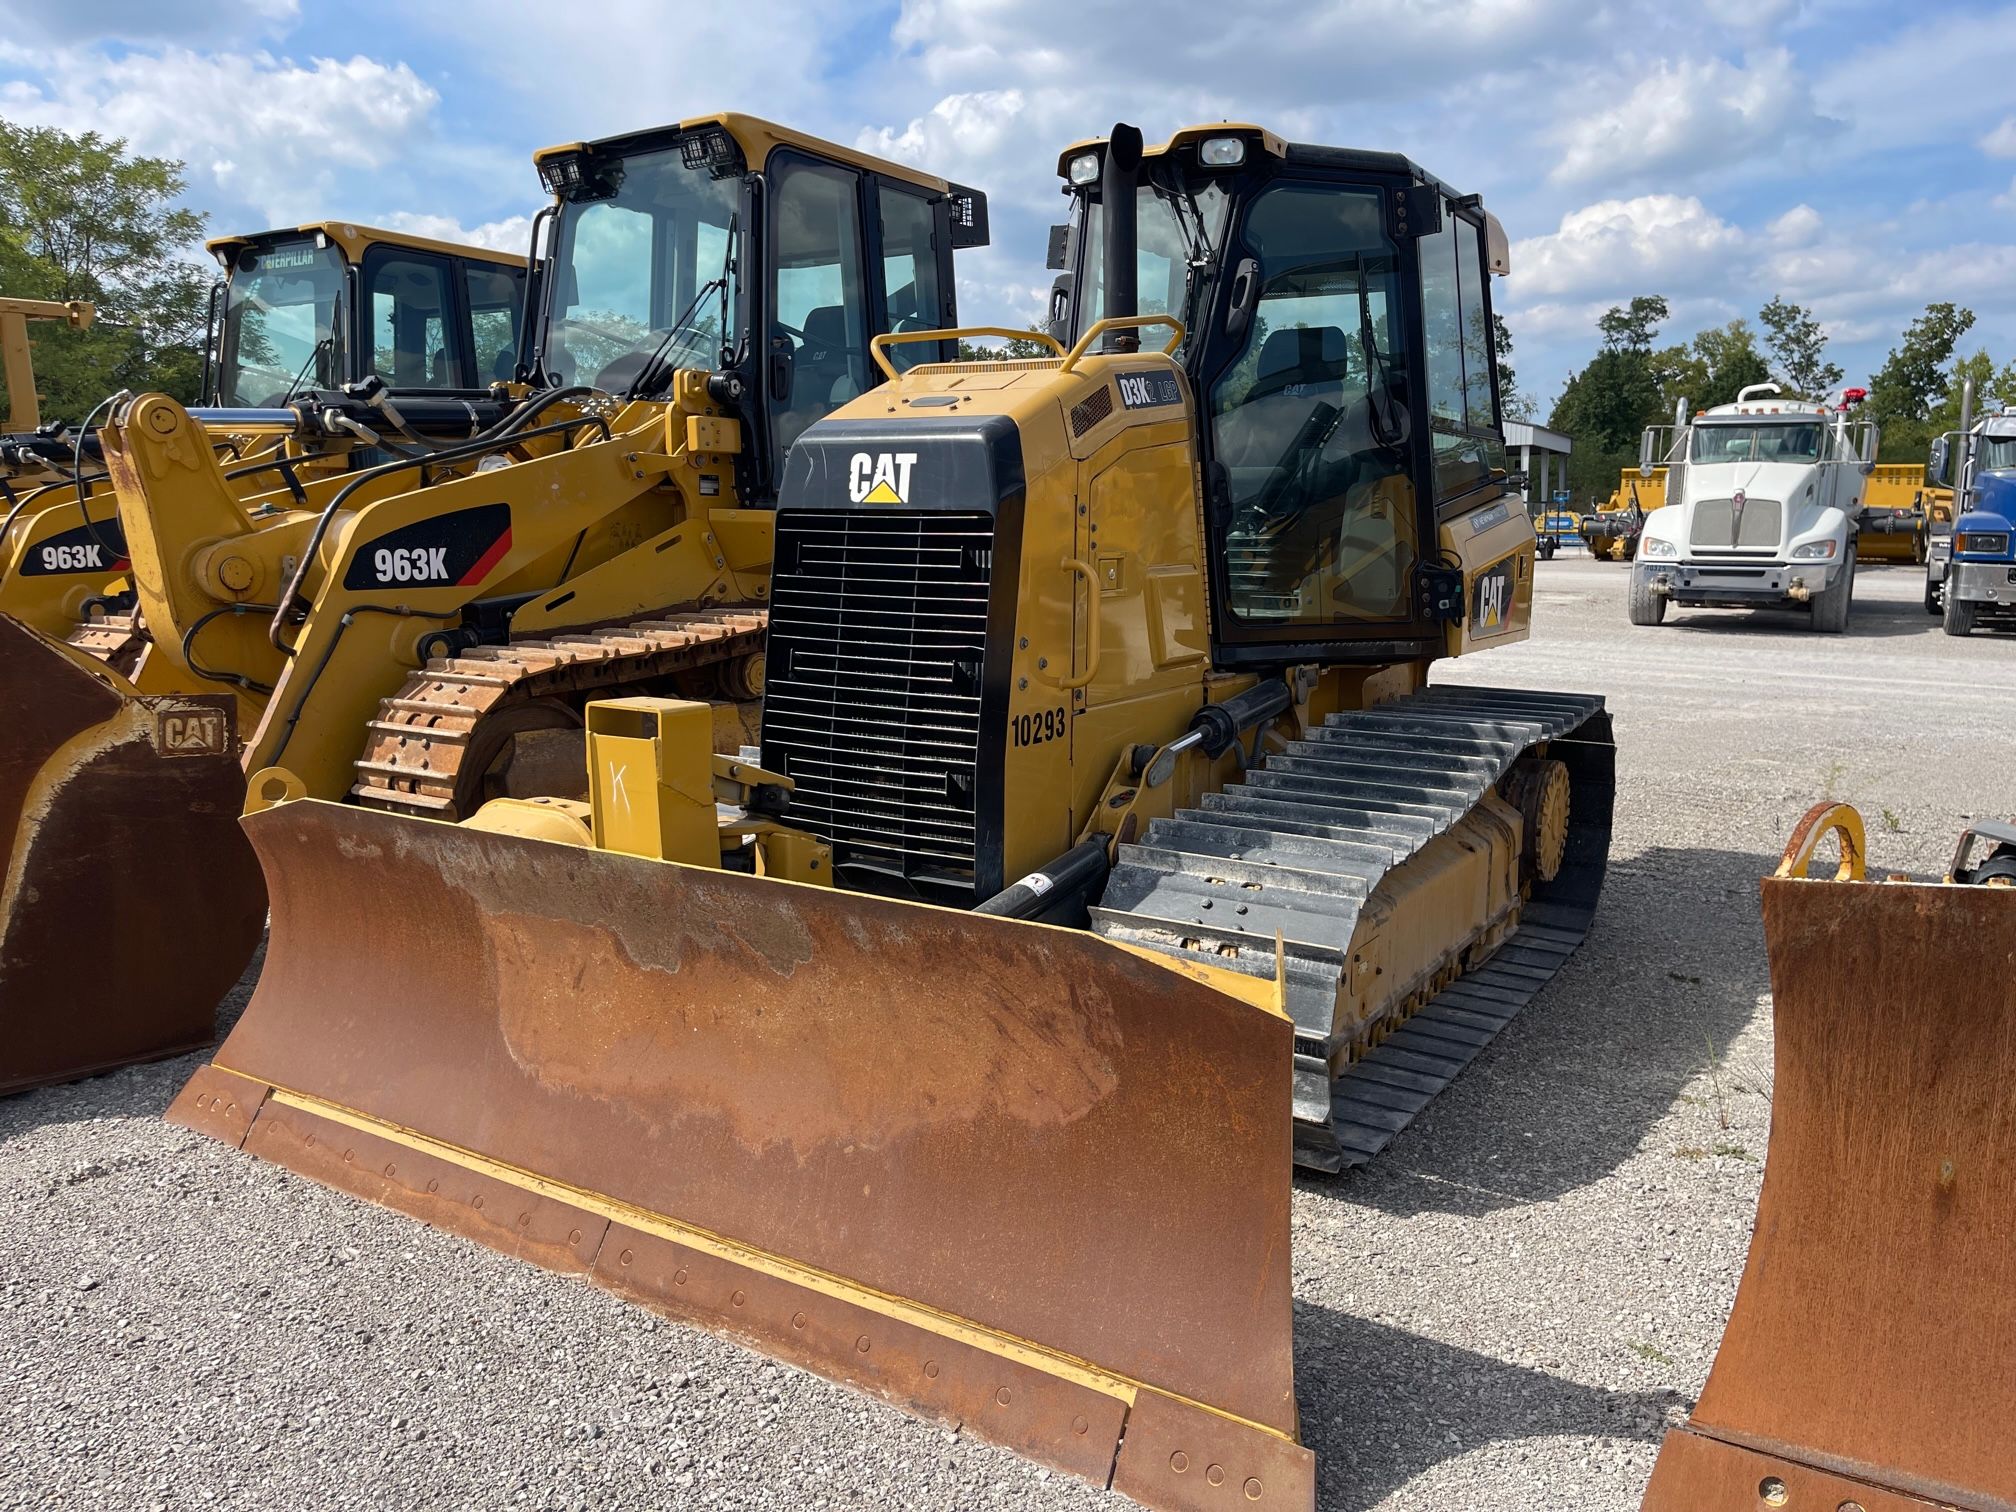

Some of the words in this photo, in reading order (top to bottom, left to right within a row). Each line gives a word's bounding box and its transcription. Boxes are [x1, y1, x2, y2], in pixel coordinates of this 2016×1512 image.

[261, 250, 314, 269] CATERPILLAR
[1158, 381, 1178, 401] LGP
[849, 452, 918, 504] CAT
[42, 544, 103, 570] 963K
[374, 547, 449, 582] 963K
[1480, 575, 1505, 628] CAT
[165, 717, 217, 749] CAT
[1011, 706, 1066, 748] 10293
[609, 760, 631, 814] K
